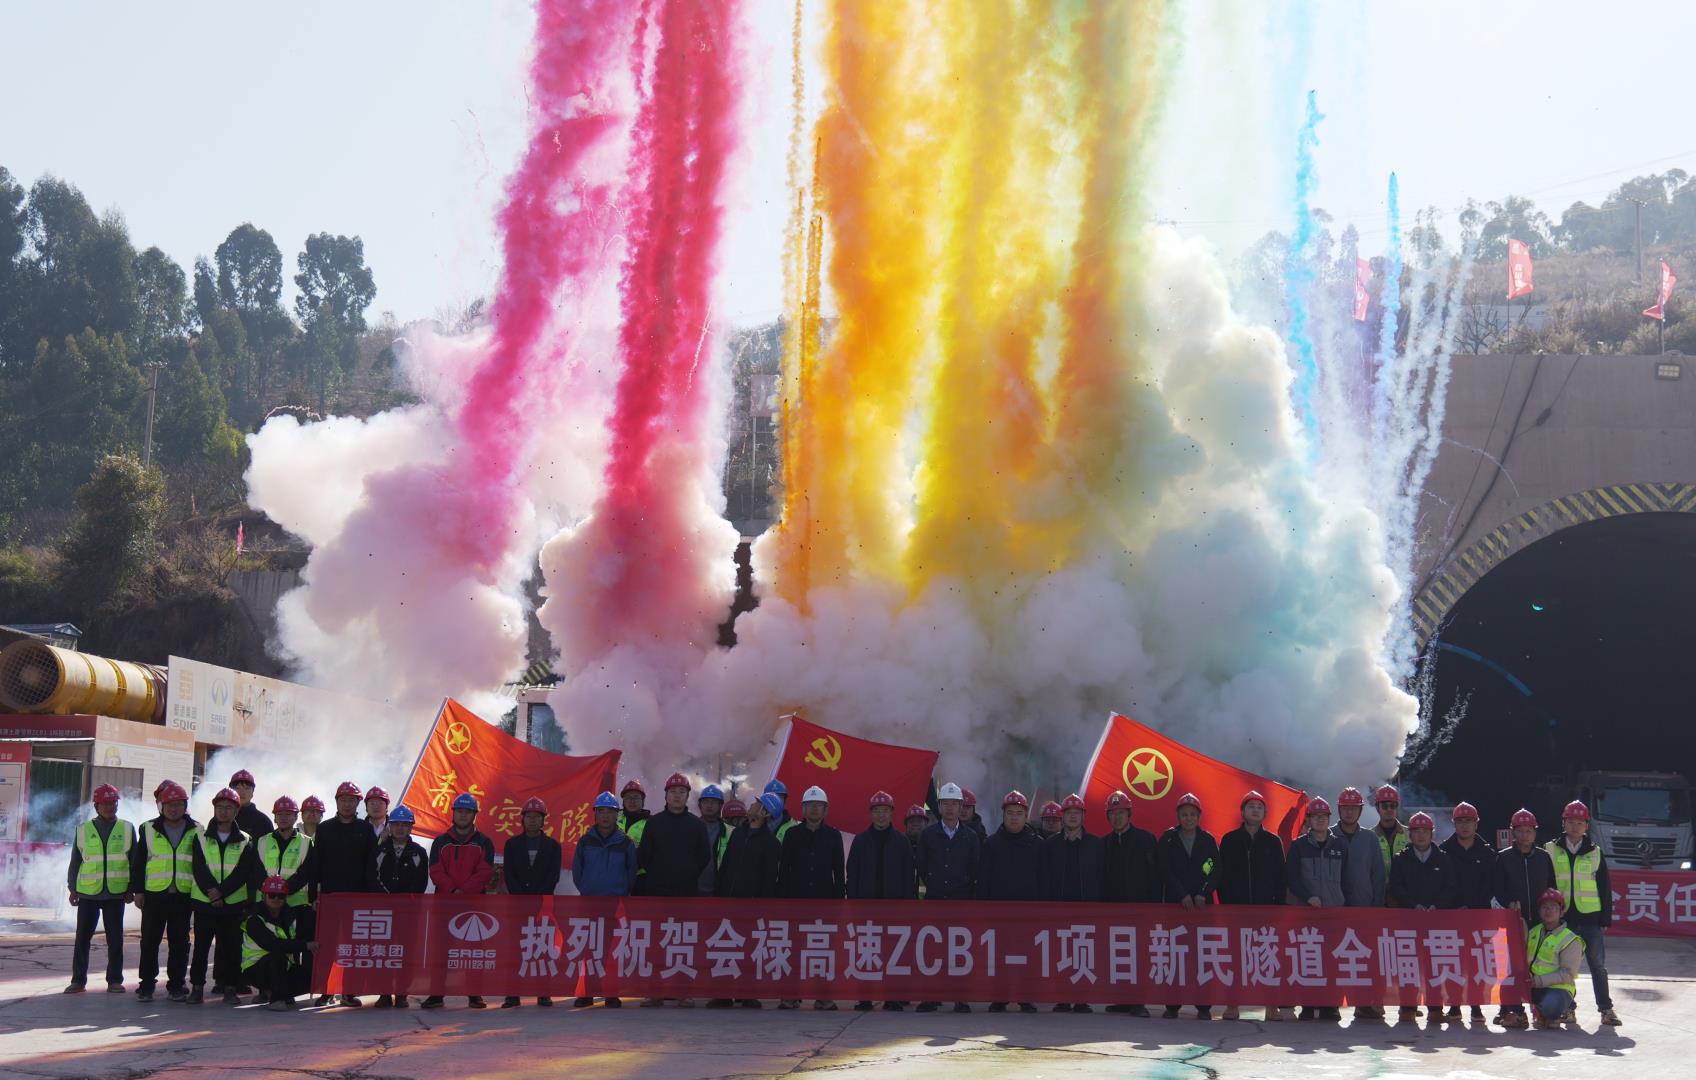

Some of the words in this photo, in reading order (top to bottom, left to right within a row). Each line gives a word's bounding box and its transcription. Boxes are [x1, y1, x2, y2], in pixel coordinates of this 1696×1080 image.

[336, 944, 404, 957] 蜀道集团
[518, 915, 1515, 987] 热烈祝贺会禄高速ZCB1-1项目新民隧道全幅贯通
[336, 959, 403, 969] SDIG
